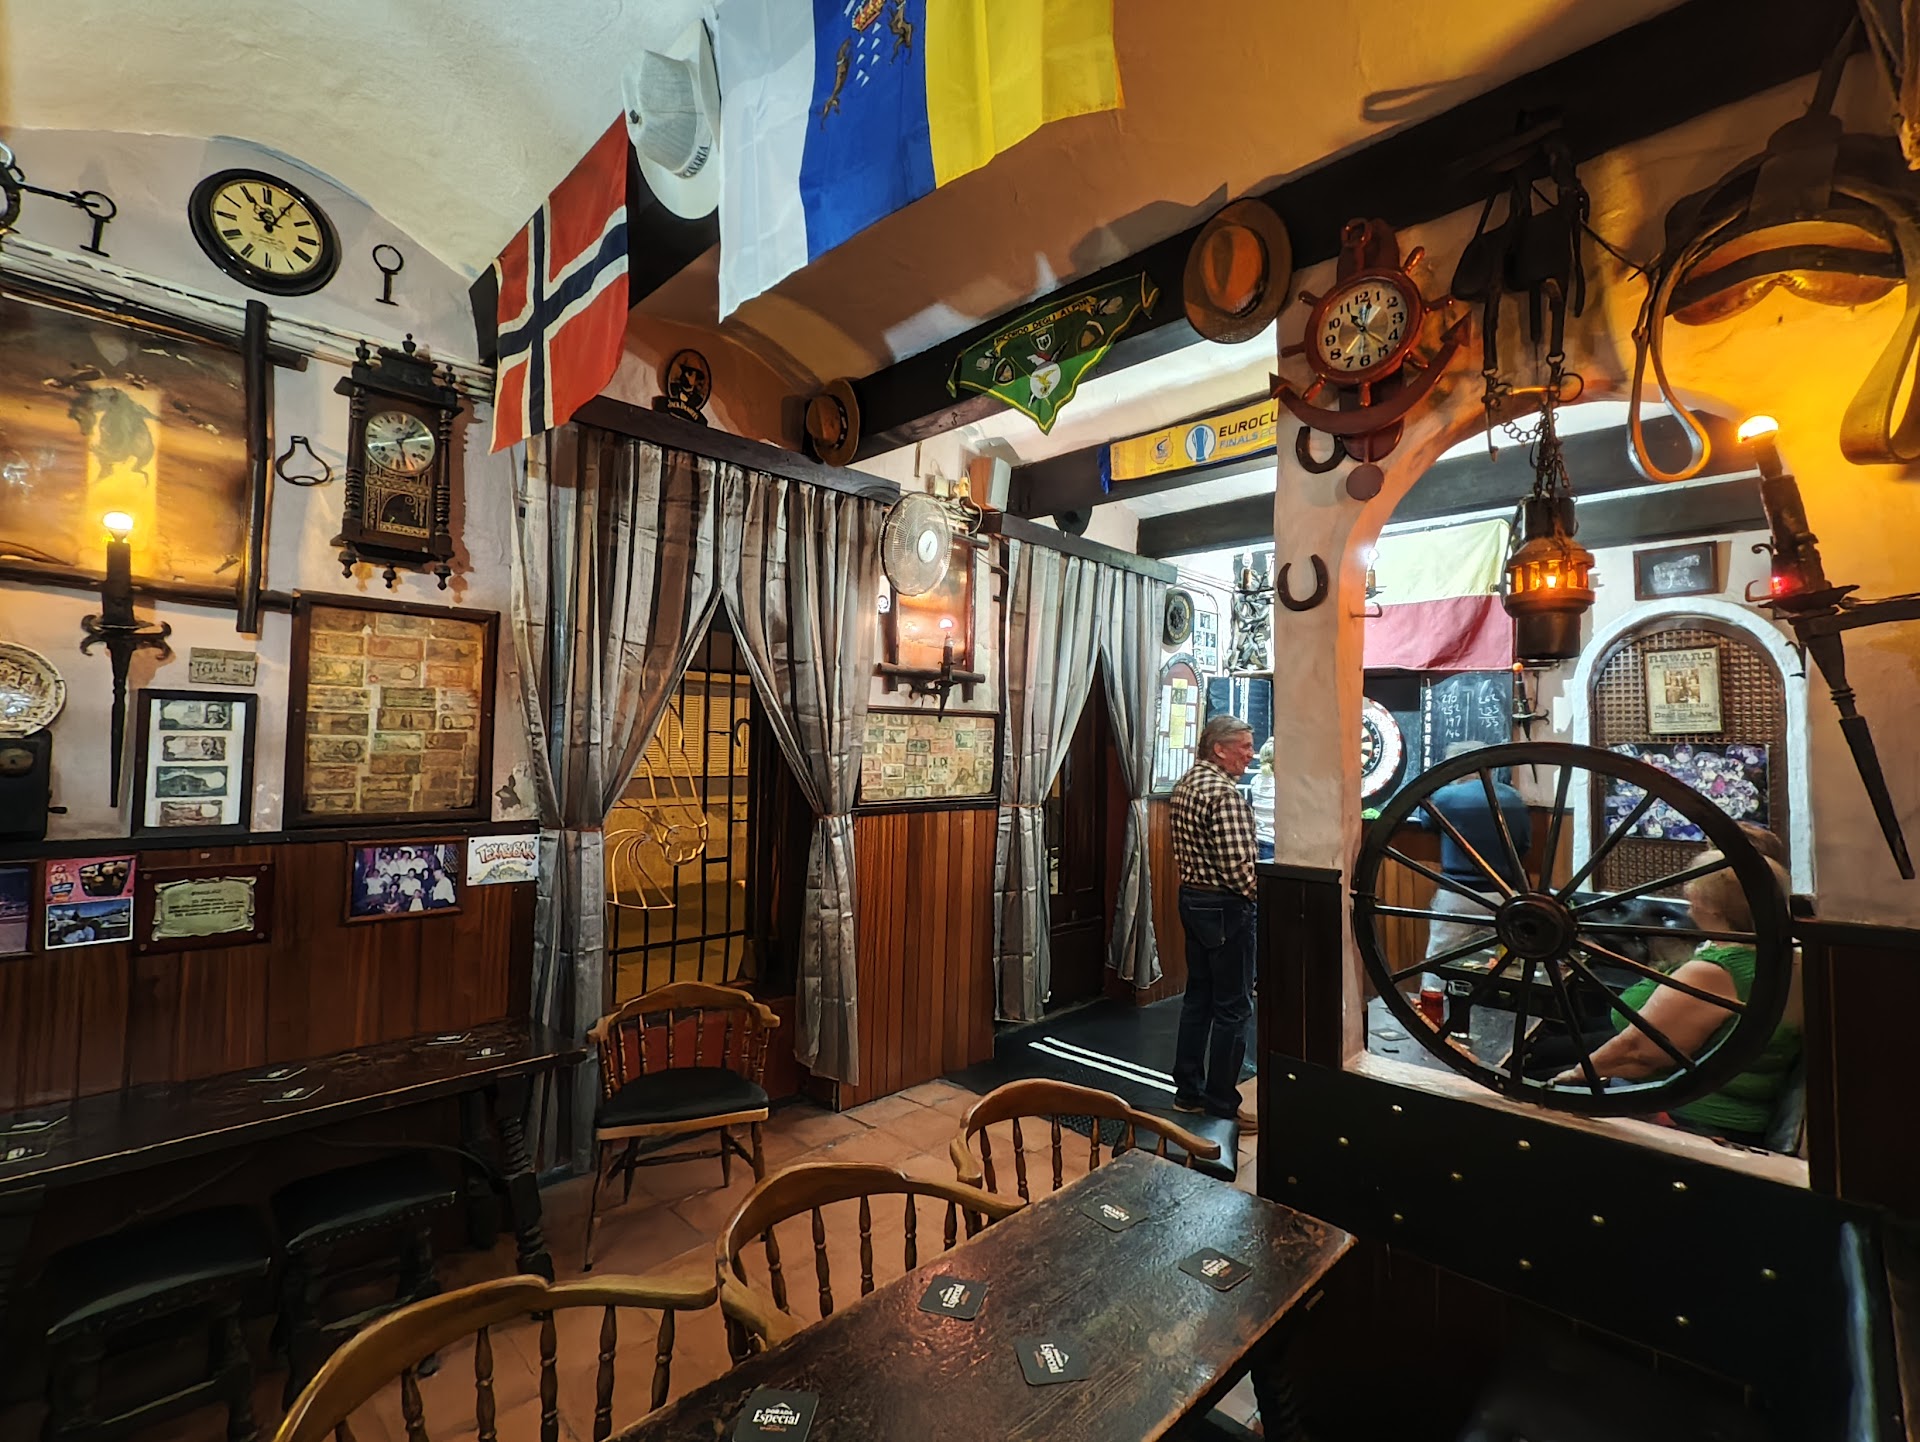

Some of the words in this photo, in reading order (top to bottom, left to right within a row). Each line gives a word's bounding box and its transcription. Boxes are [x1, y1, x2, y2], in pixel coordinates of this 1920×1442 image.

[1354, 291, 1370, 305] 12
[1376, 290, 1381, 301] 1
[1339, 302, 1351, 314] 11
[1387, 296, 1399, 309] 2
[1033, 313, 1056, 330] DEGLI
[1328, 317, 1341, 330] 10
[1392, 311, 1404, 325] 3
[1325, 334, 1336, 347] 9
[1388, 328, 1399, 341] 4
[1330, 348, 1342, 360] 8
[1359, 354, 1371, 367] 6
[1343, 355, 1355, 368] 7
[1219, 431, 1259, 449] FINALS
[1648, 651, 1713, 664] REWARD
[1425, 689, 1432, 700] 2
[1425, 701, 1432, 712] 3
[1424, 746, 1431, 757] 7
[1423, 757, 1431, 768] 8
[475, 842, 513, 864] TEXAS
[513, 841, 537, 860] BAR
[752, 1409, 801, 1426] Especial
